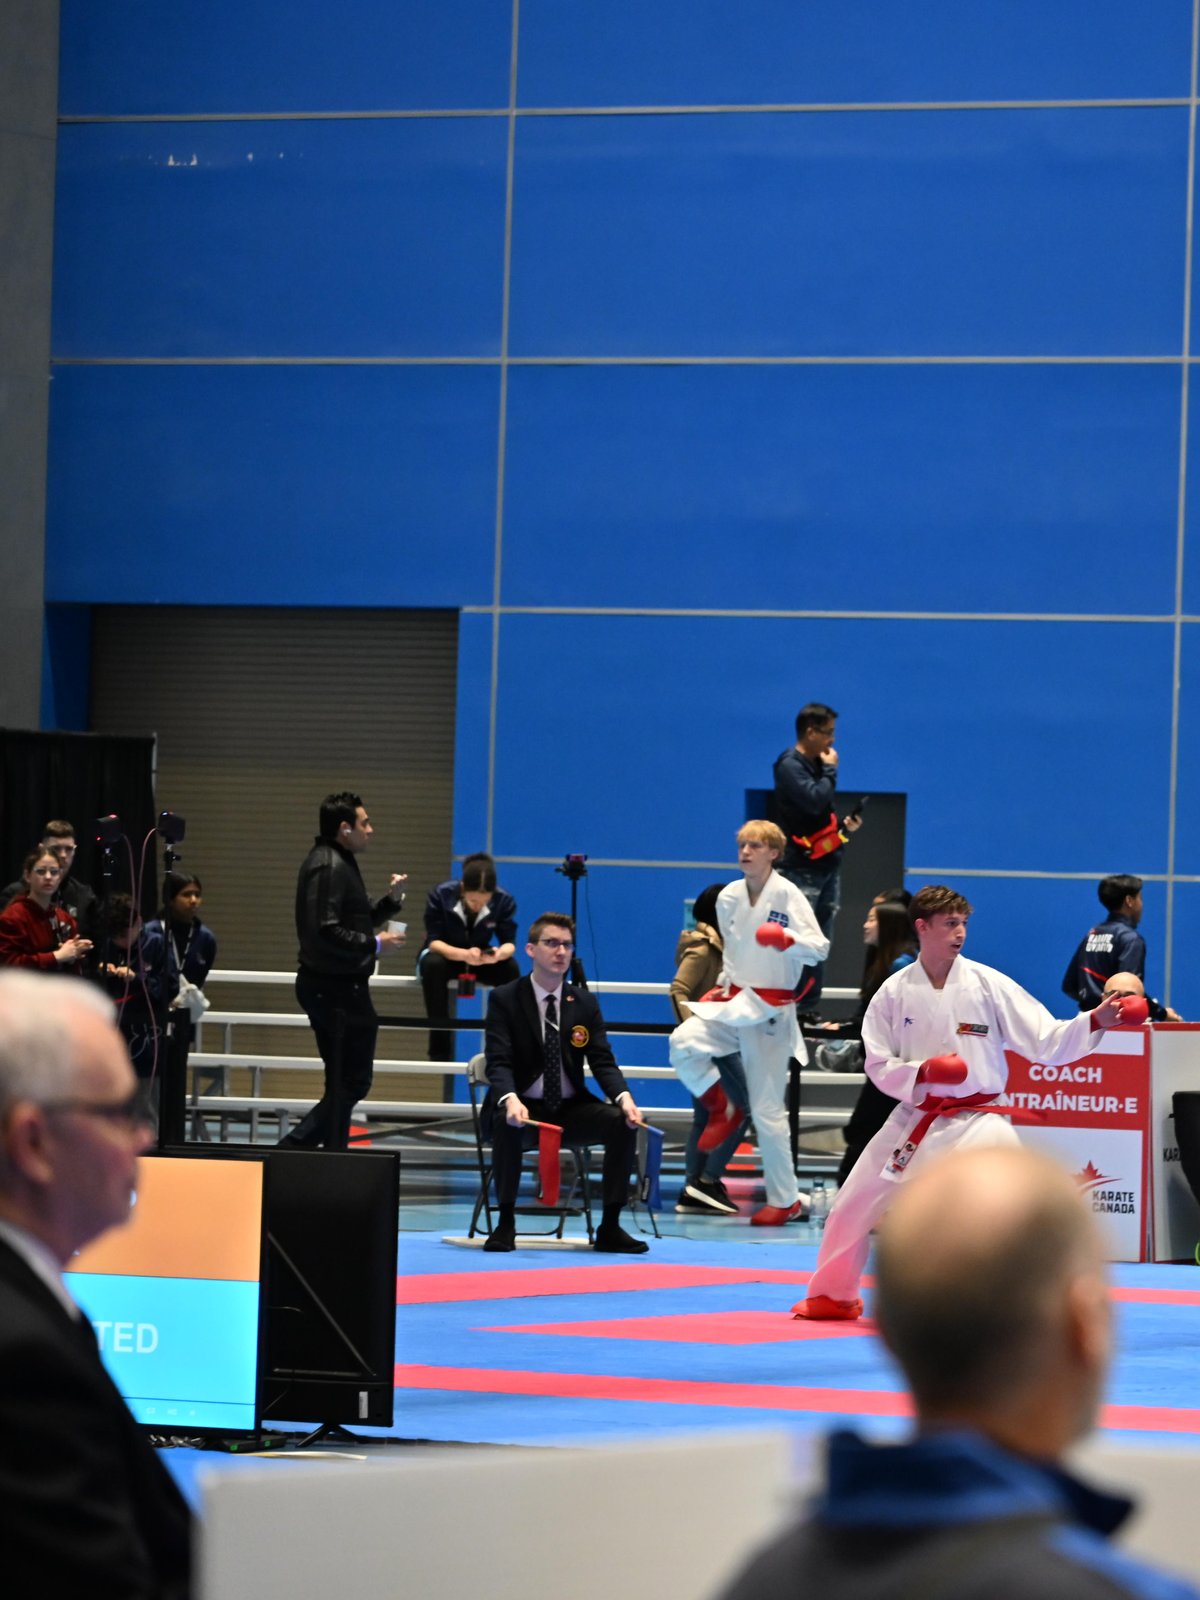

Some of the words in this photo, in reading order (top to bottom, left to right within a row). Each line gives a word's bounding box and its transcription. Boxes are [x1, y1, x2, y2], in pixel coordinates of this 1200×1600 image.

[1028, 1065, 1103, 1083] COACH
[1000, 1090, 1138, 1113] NTRAÎNEUR·E
[1093, 1190, 1135, 1202] KARATE
[1093, 1202, 1135, 1214] CANADA
[92, 1321, 158, 1353] TED
